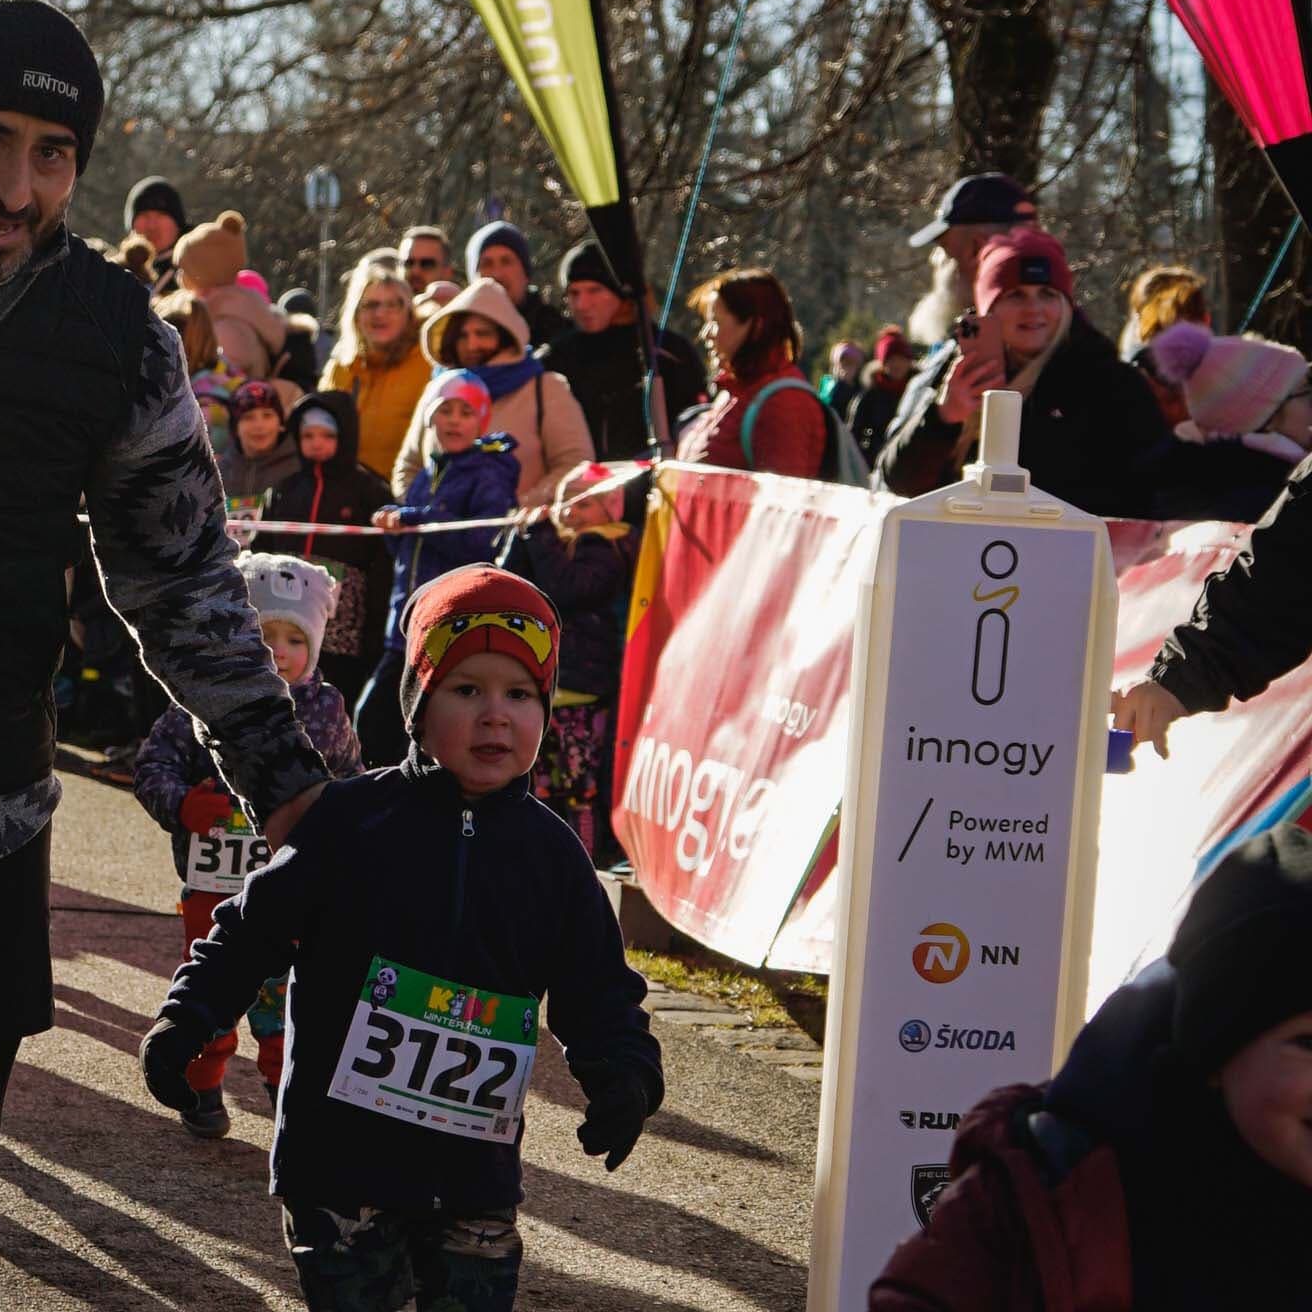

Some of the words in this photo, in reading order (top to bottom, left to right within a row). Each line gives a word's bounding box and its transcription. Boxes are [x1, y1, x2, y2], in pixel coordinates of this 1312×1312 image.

[22, 70, 79, 103] RUNTOUR
[906, 726, 1054, 776] innogy
[948, 810, 1049, 836] Powered
[946, 838, 975, 864] by
[984, 840, 1046, 864] MVM
[981, 944, 1021, 966] NN
[934, 1024, 1017, 1052] ŠKODA
[351, 1011, 518, 1111] 3122
